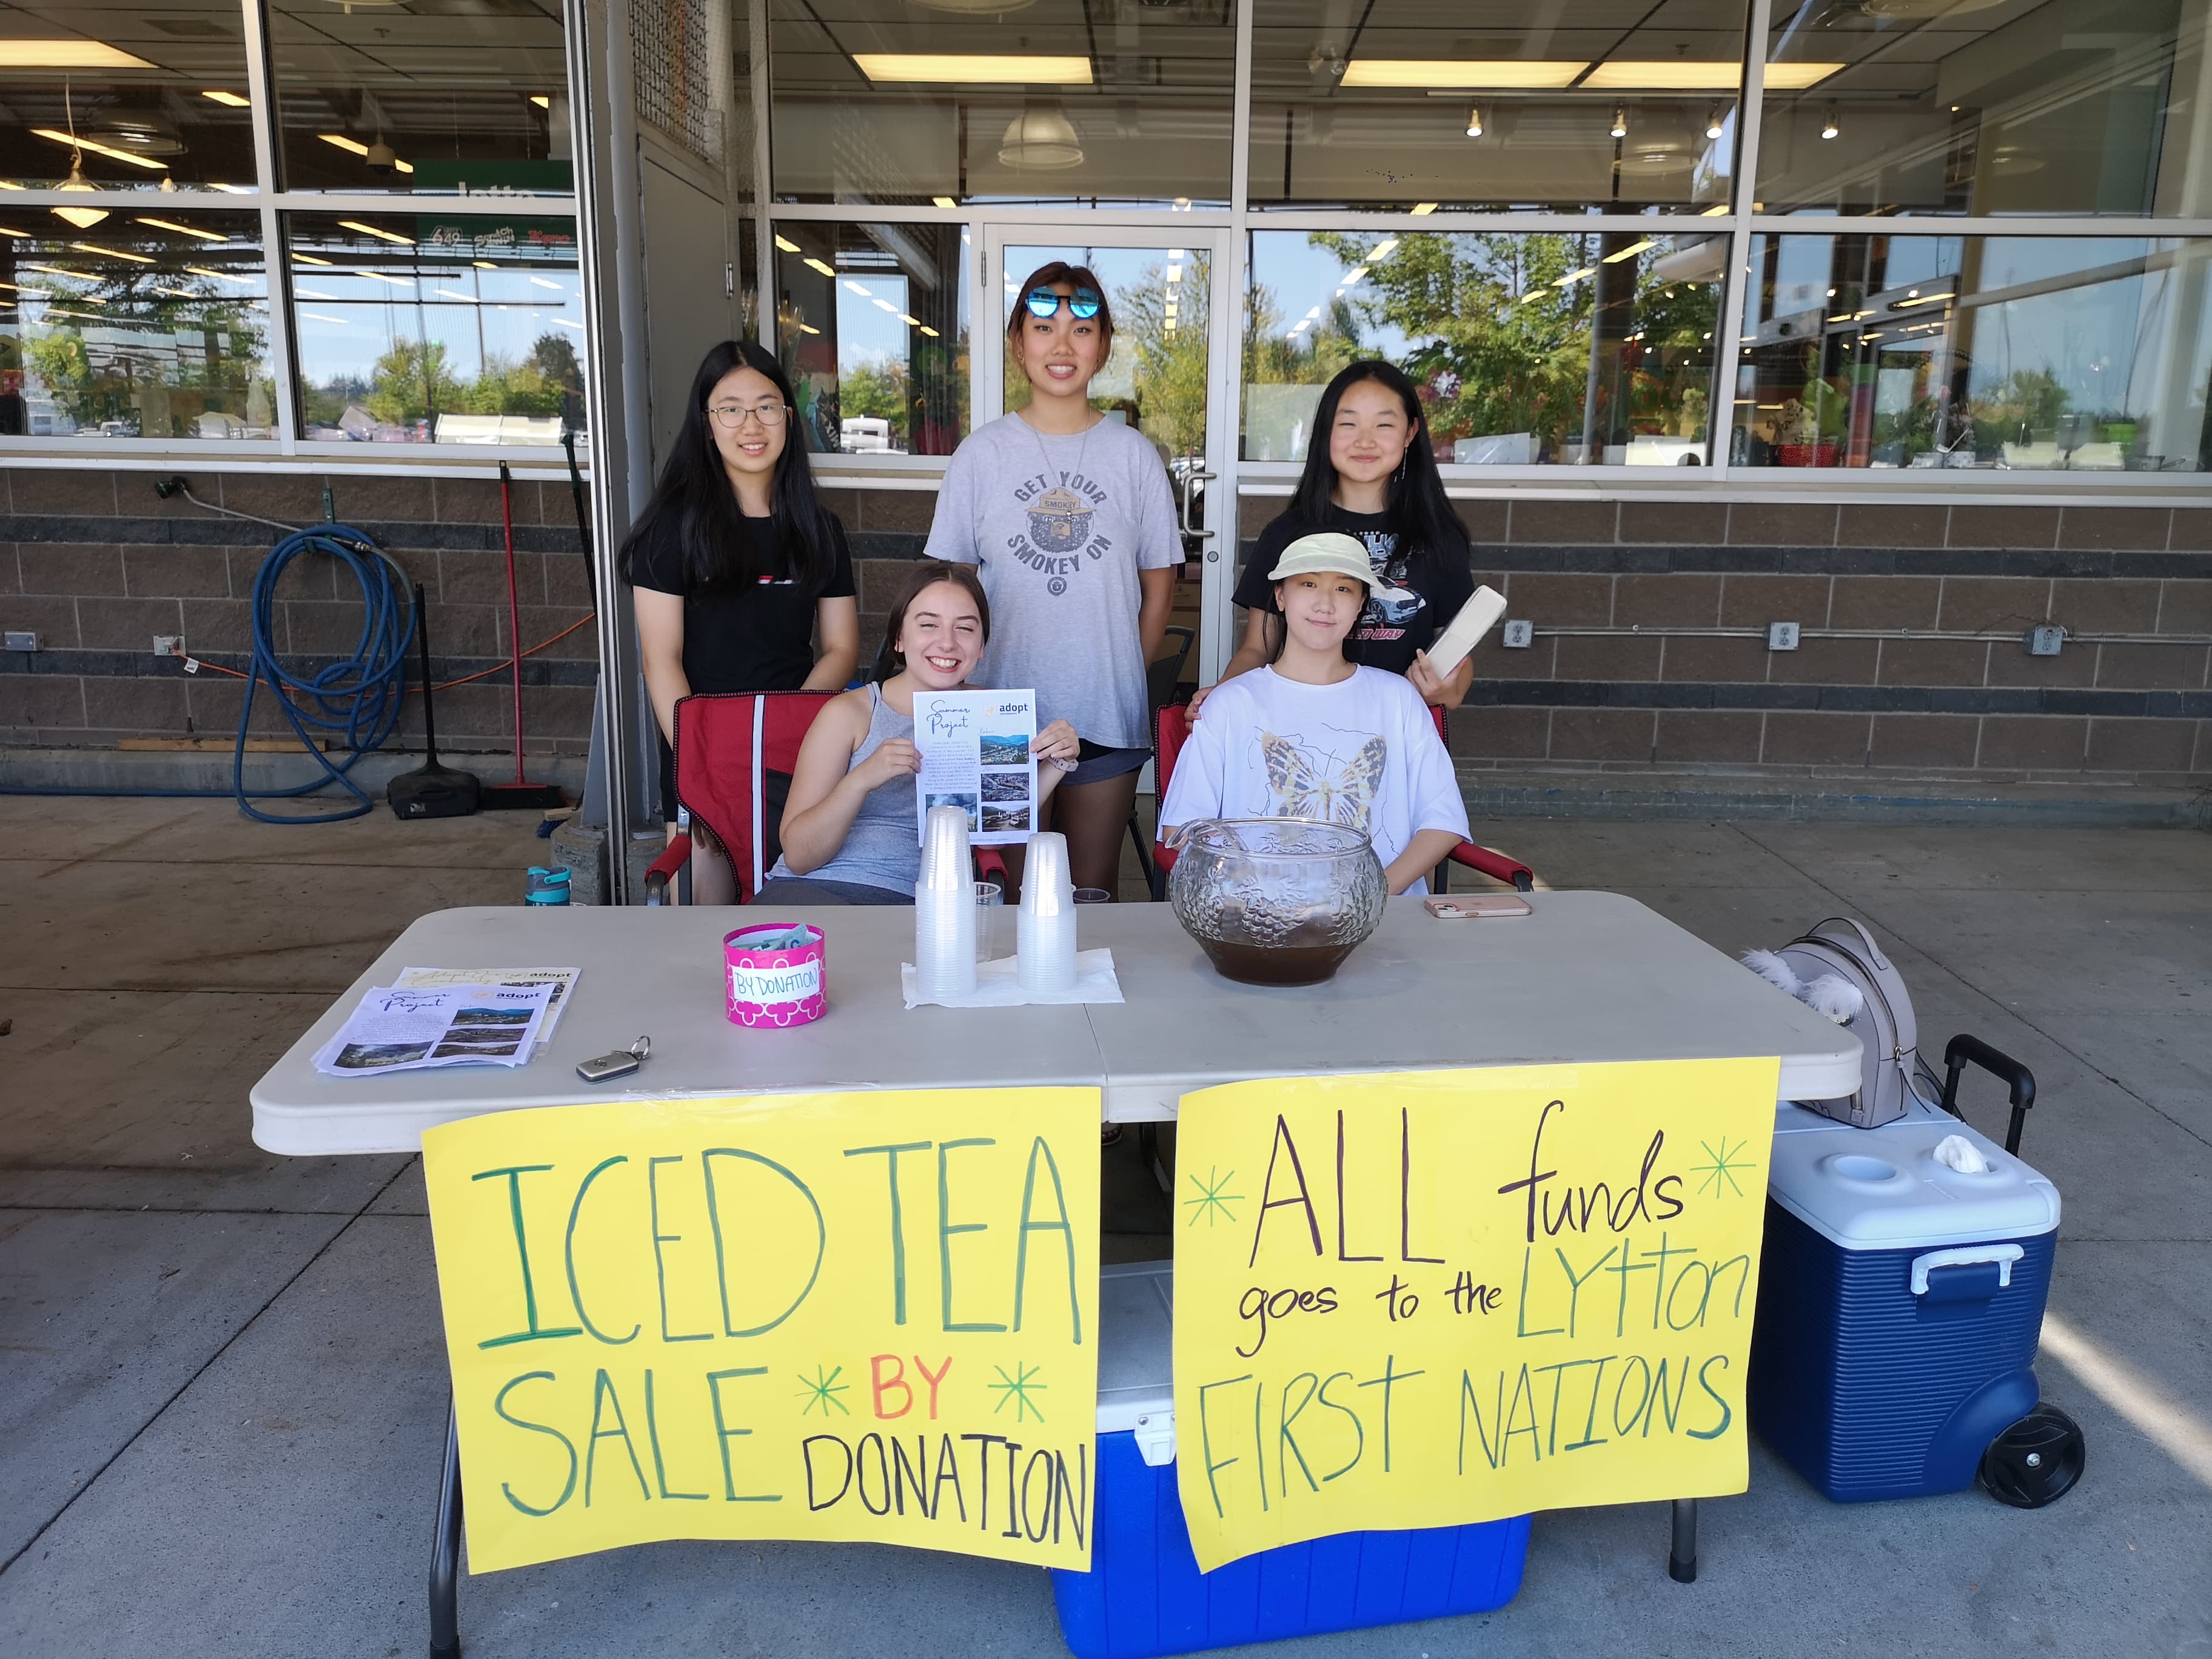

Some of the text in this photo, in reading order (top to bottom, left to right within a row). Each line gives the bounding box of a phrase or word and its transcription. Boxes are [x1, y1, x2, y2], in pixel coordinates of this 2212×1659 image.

[1014, 471, 1107, 504] GET YOUR
[1045, 500, 1077, 509] SMOKEY
[1007, 534, 1112, 575] SMOKEY ON
[926, 714, 969, 738] Project
[931, 699, 1028, 717] Summer adopt
[734, 967, 817, 996] BY DONATION
[380, 998, 444, 1012] Project
[1248, 1099, 1685, 1269] ALL funds
[471, 1136, 1081, 1349] ICED TEA
[1235, 1285, 1338, 1358] goes
[1375, 1273, 1420, 1322] to
[1444, 1270, 1504, 1315] the
[494, 1353, 953, 1517] SALE BY
[1458, 1355, 1732, 1476] NATIONS
[802, 1433, 1087, 1550] DONATION
